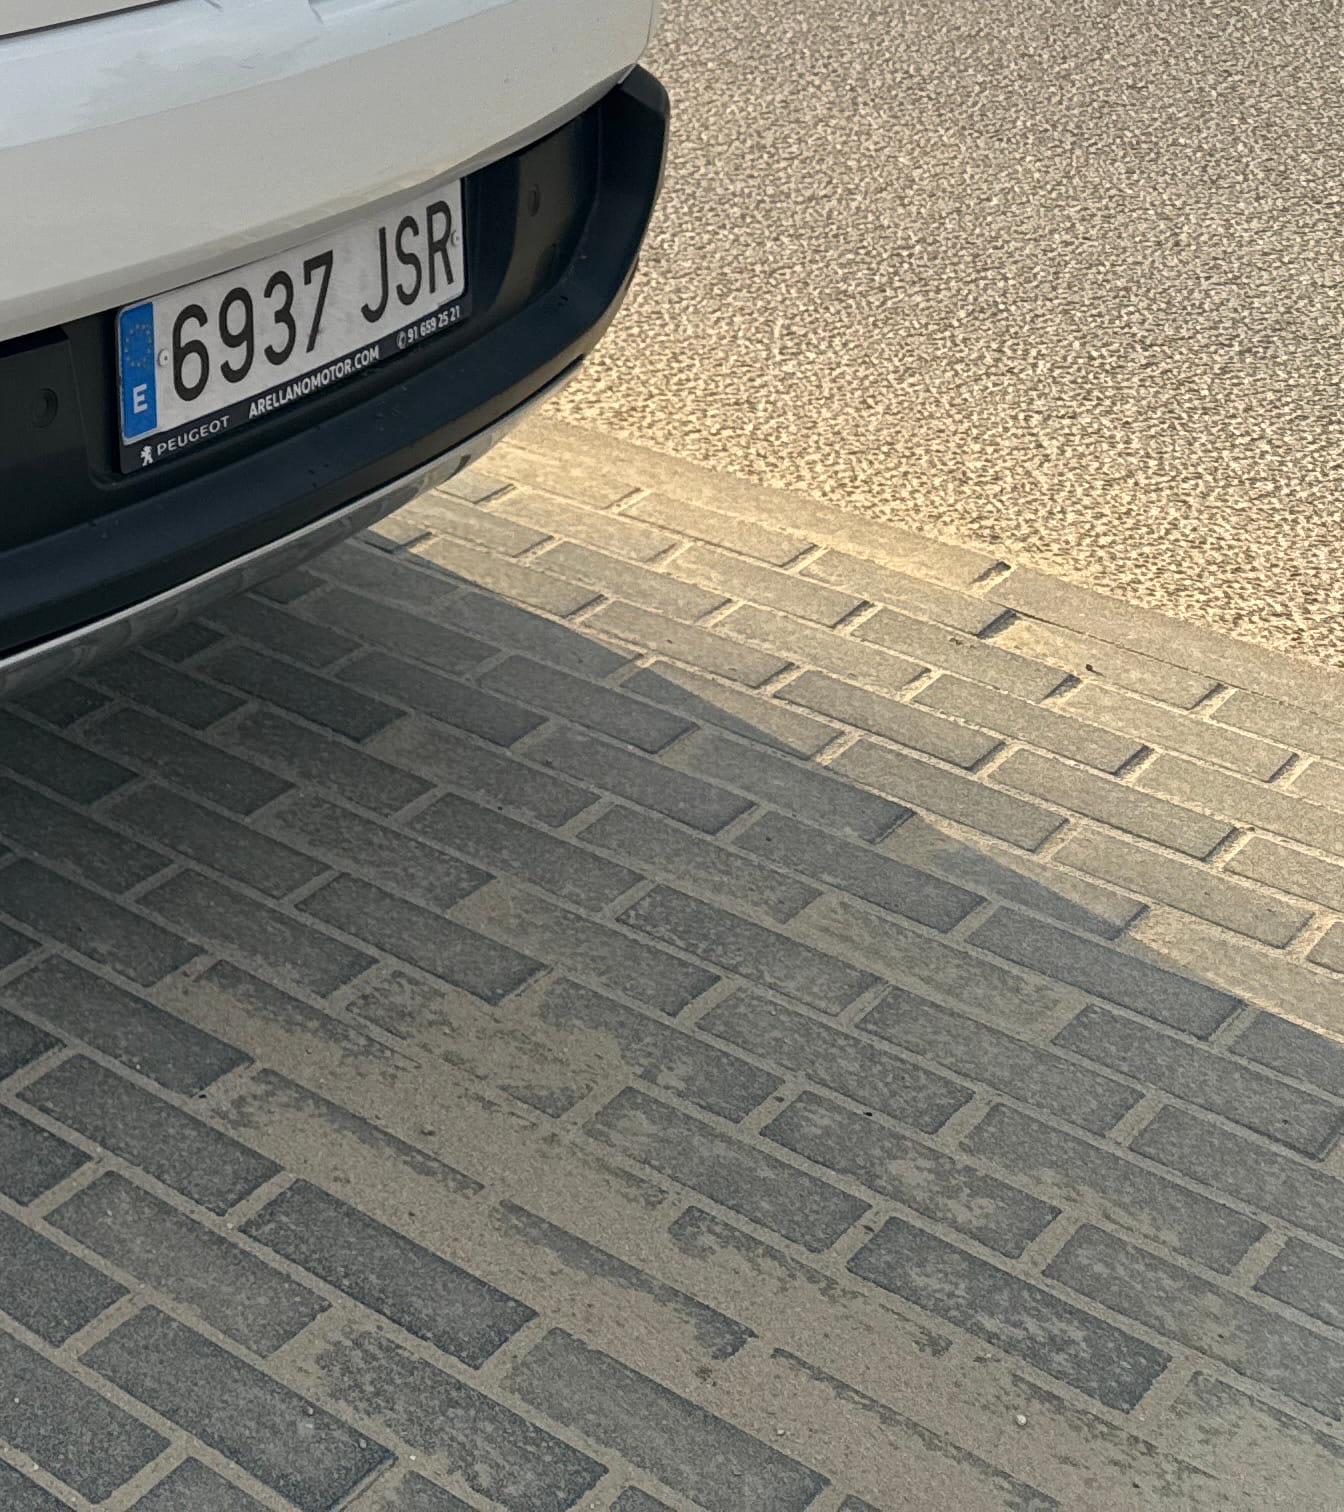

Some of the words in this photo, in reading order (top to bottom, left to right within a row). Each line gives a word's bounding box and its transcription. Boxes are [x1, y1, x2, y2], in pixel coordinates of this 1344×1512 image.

[172, 249, 334, 402] 6937
[361, 200, 455, 323] JSR
[132, 383, 148, 414] E
[156, 415, 231, 456] PEUGEOT
[248, 345, 380, 420] ARELLANOMOTOR.COM
[420, 317, 437, 336] 659
